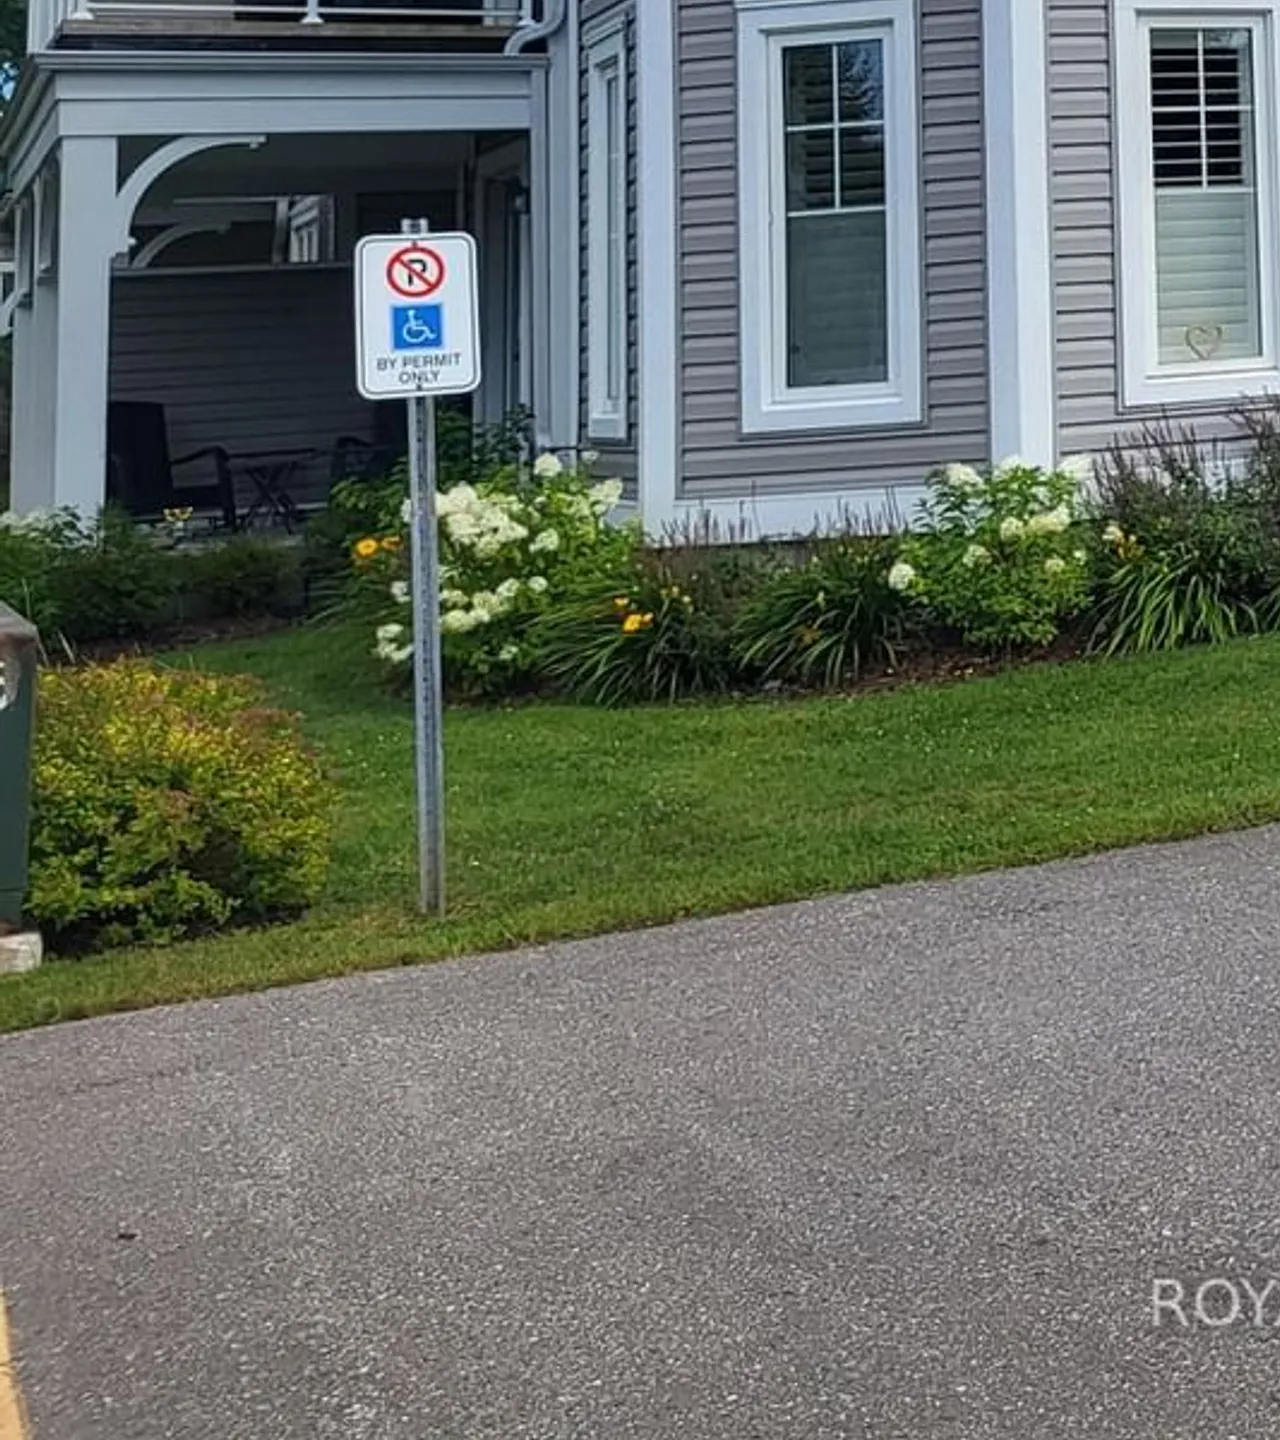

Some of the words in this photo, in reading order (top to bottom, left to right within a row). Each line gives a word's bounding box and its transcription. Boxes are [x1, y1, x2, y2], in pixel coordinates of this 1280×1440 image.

[377, 357, 396, 371] BY
[402, 352, 461, 369] PERMIT
[398, 370, 440, 384] ONLY
